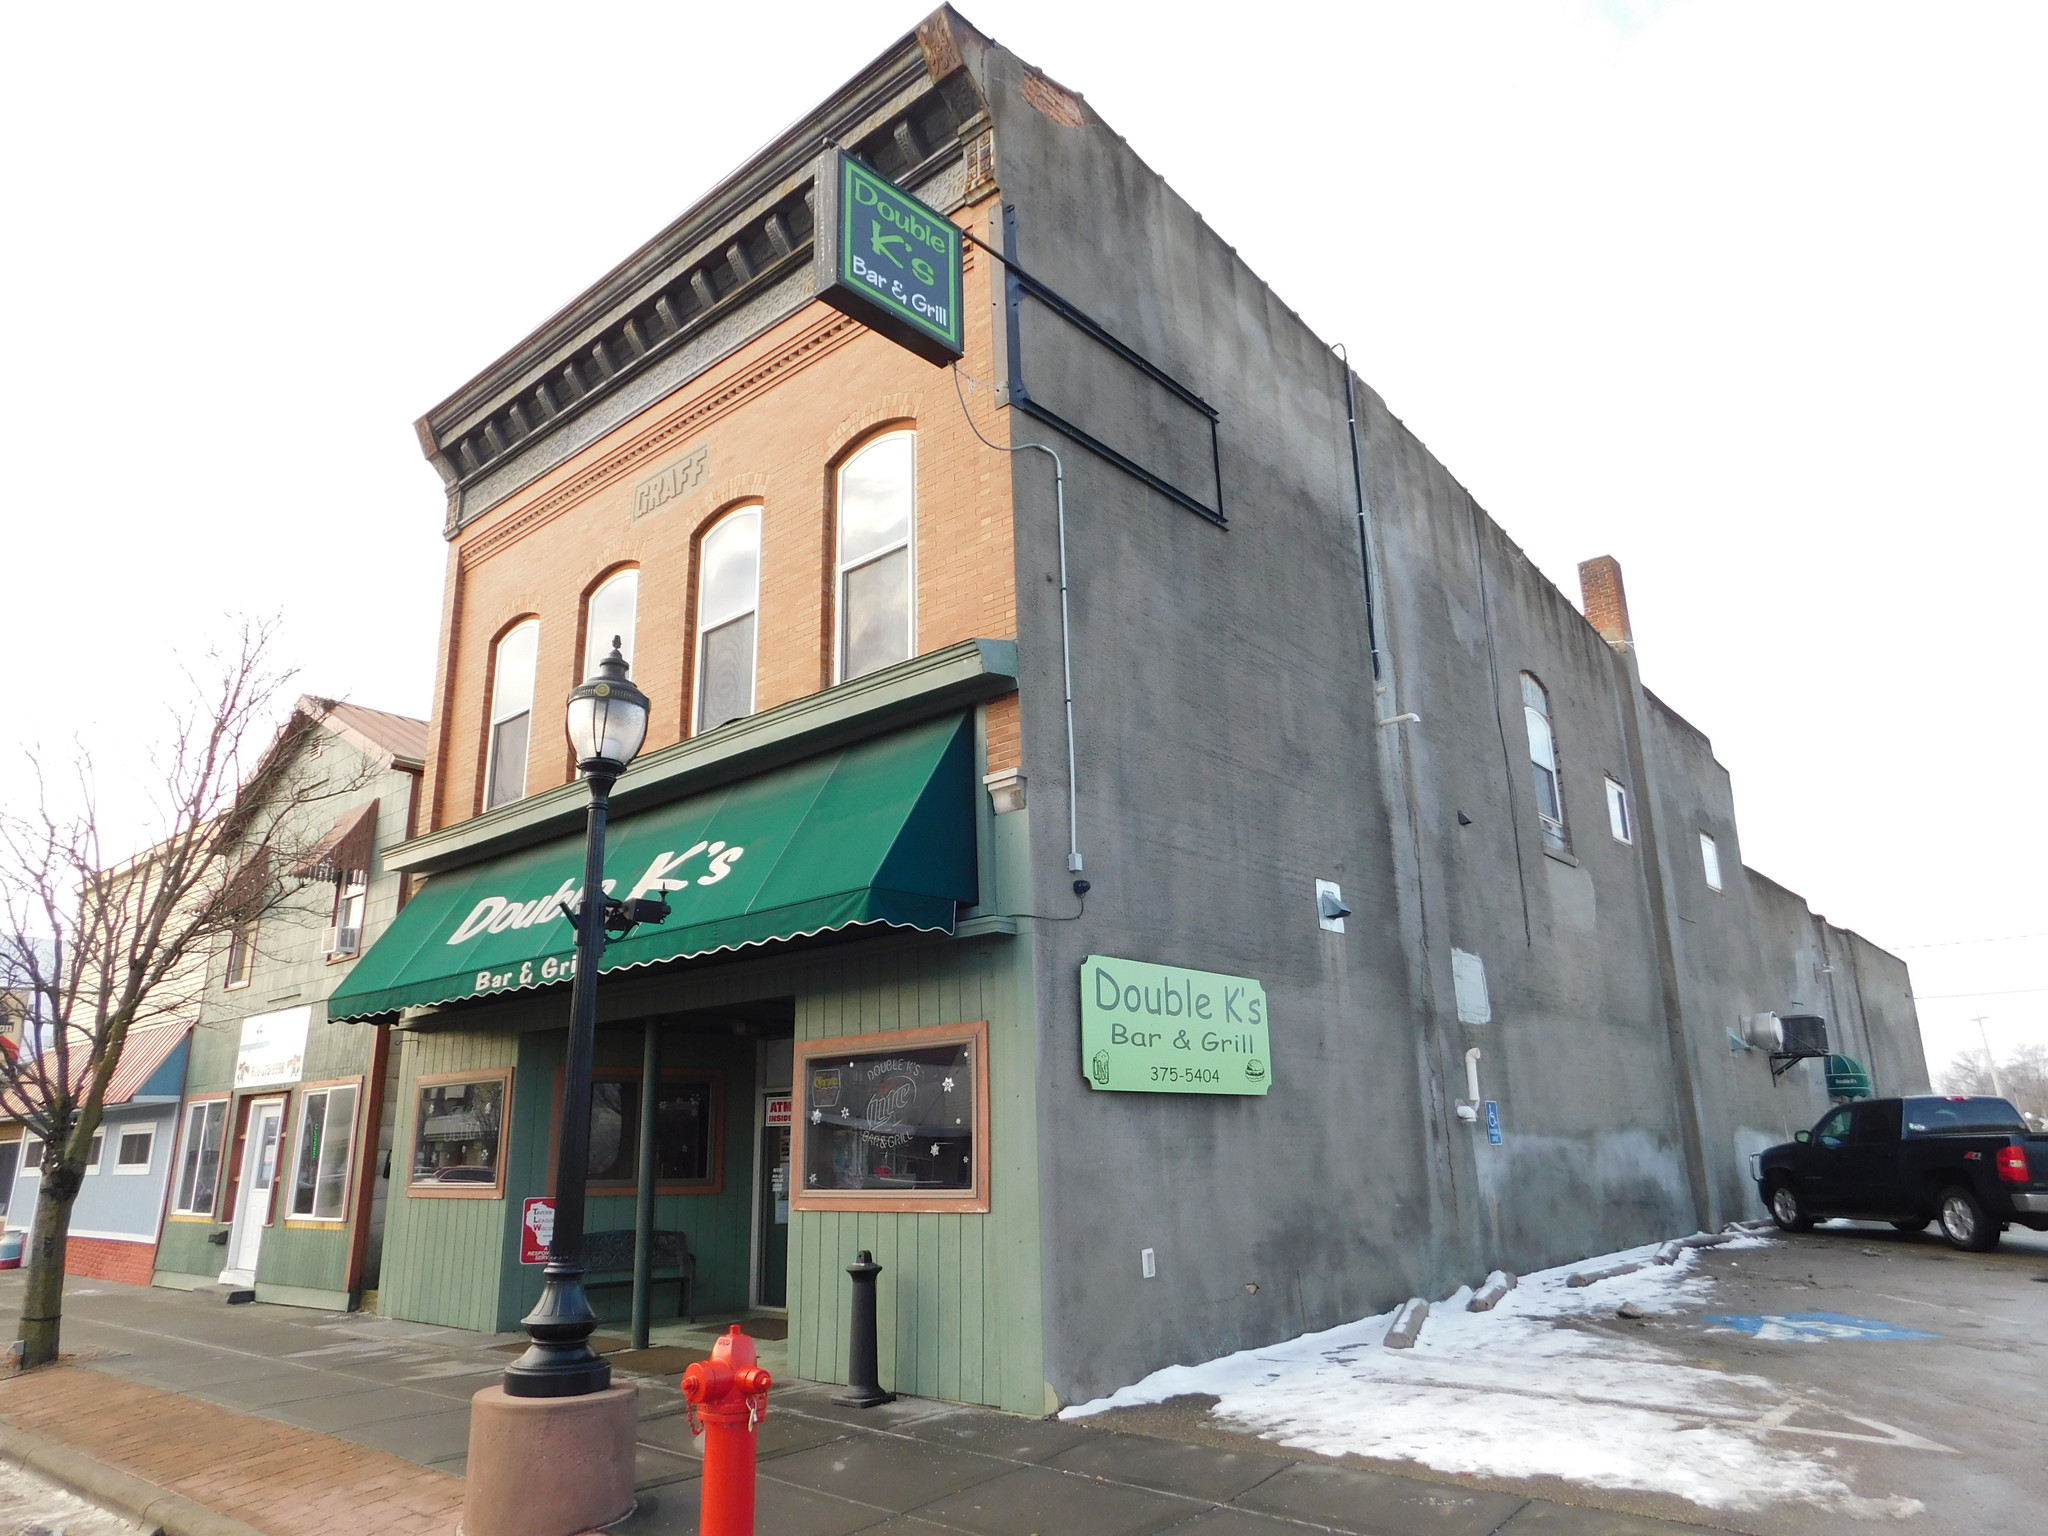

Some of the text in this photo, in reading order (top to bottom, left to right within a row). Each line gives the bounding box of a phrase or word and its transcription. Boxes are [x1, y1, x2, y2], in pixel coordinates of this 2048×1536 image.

[855, 177, 946, 254] Double
[870, 219, 935, 287] K's
[853, 254, 947, 327] Bar & Grill
[637, 449, 707, 519] GRAFF
[618, 840, 744, 908] K's
[475, 954, 577, 991] Bar & Gri
[1095, 966, 1262, 1025] Double K's
[1111, 1023, 1254, 1054] Bar & Grill
[867, 1059, 921, 1081] DOUBLE K'S
[1150, 1066, 1220, 1084] 375-5404
[769, 1114, 792, 1122] INSID
[770, 1101, 792, 1113] ATM
[887, 1130, 914, 1149] GRILL
